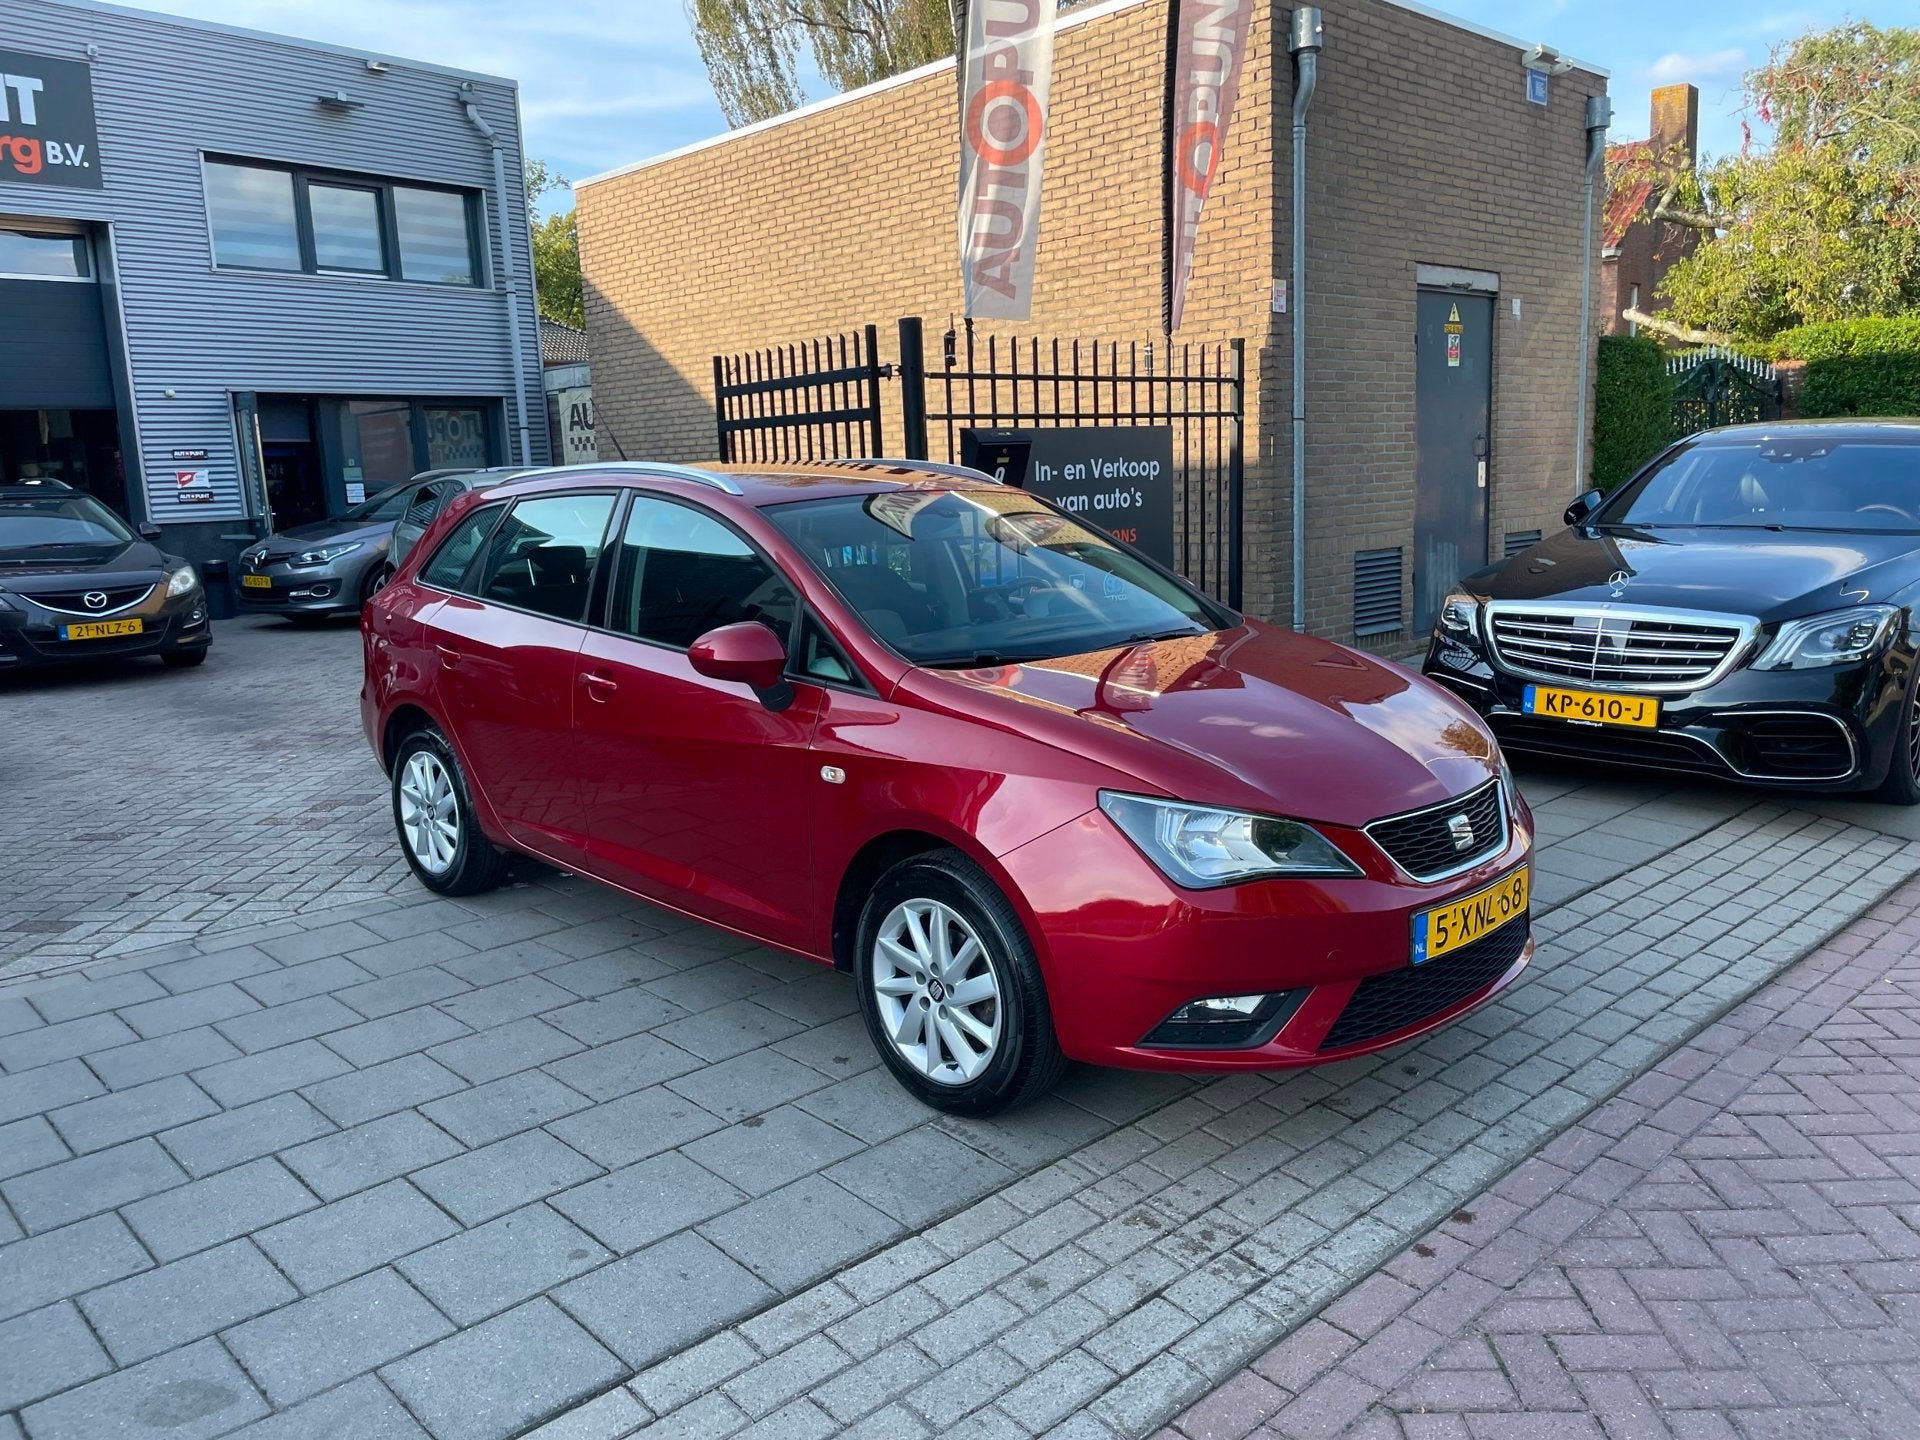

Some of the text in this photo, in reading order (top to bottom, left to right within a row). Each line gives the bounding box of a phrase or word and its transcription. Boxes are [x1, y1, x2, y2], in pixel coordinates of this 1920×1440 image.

[46, 140, 89, 168] B.V.
[1035, 456, 1161, 482] In- en Verkoop
[1056, 487, 1143, 512] van auto's
[75, 621, 136, 638] 21-NLZ-6
[1545, 692, 1645, 722] KP-610-J
[1415, 877, 1523, 955] NL 5-XNL-68
